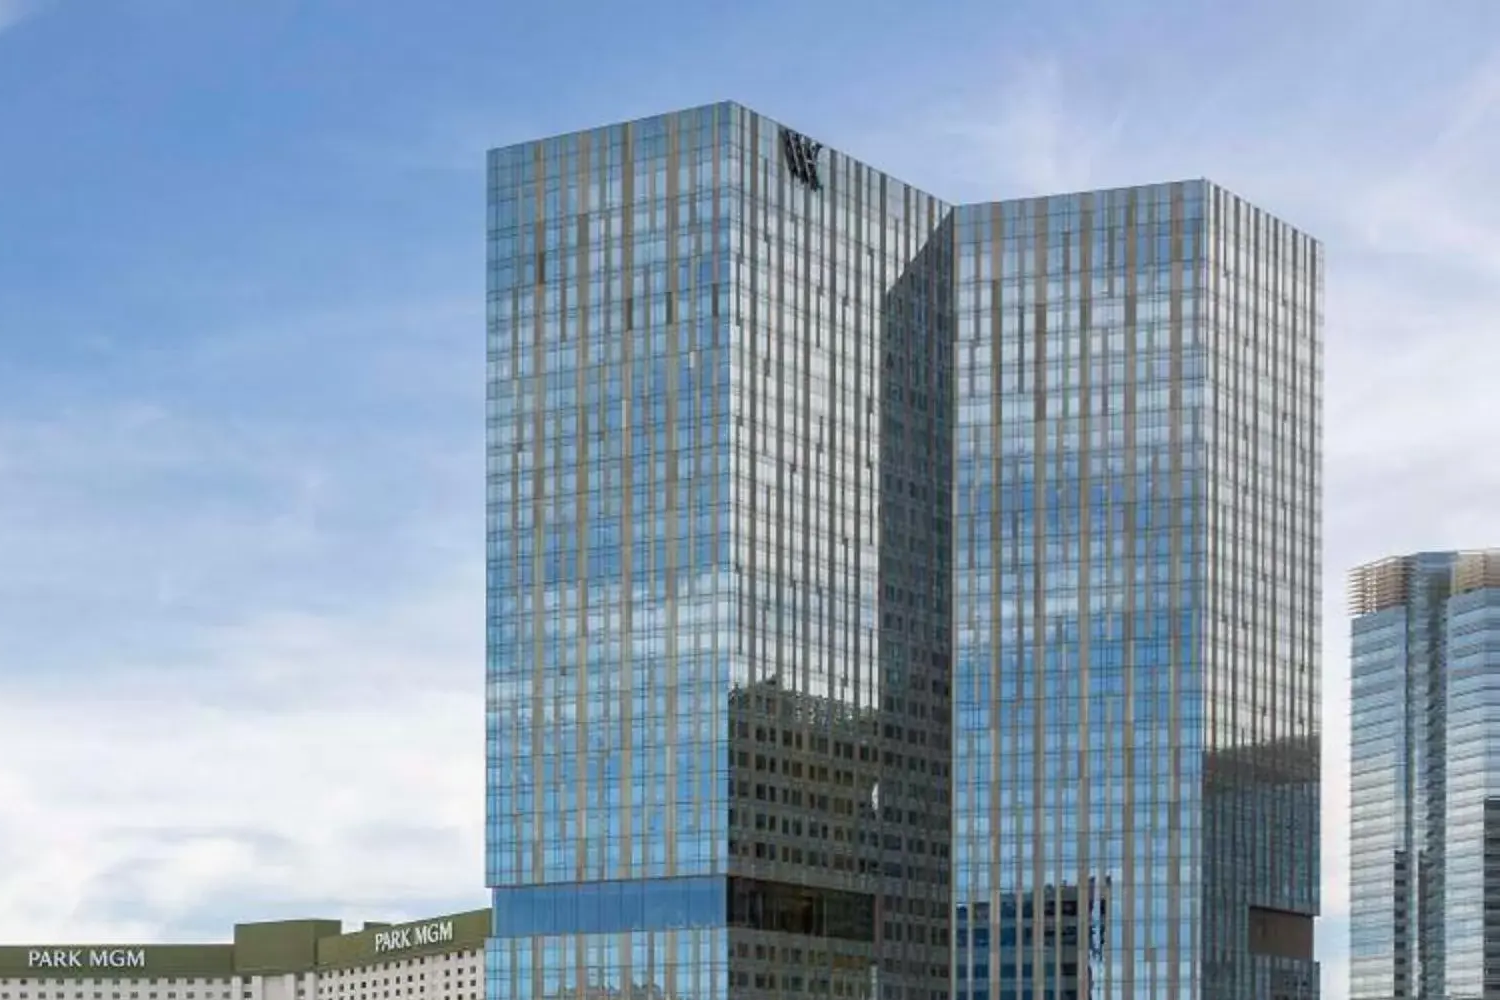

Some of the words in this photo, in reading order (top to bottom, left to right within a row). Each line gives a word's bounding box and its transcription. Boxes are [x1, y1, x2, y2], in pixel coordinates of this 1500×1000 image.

[374, 928, 412, 953] PARK
[414, 921, 453, 945] MGM
[28, 949, 82, 968] PARK
[89, 949, 145, 968] MGM
